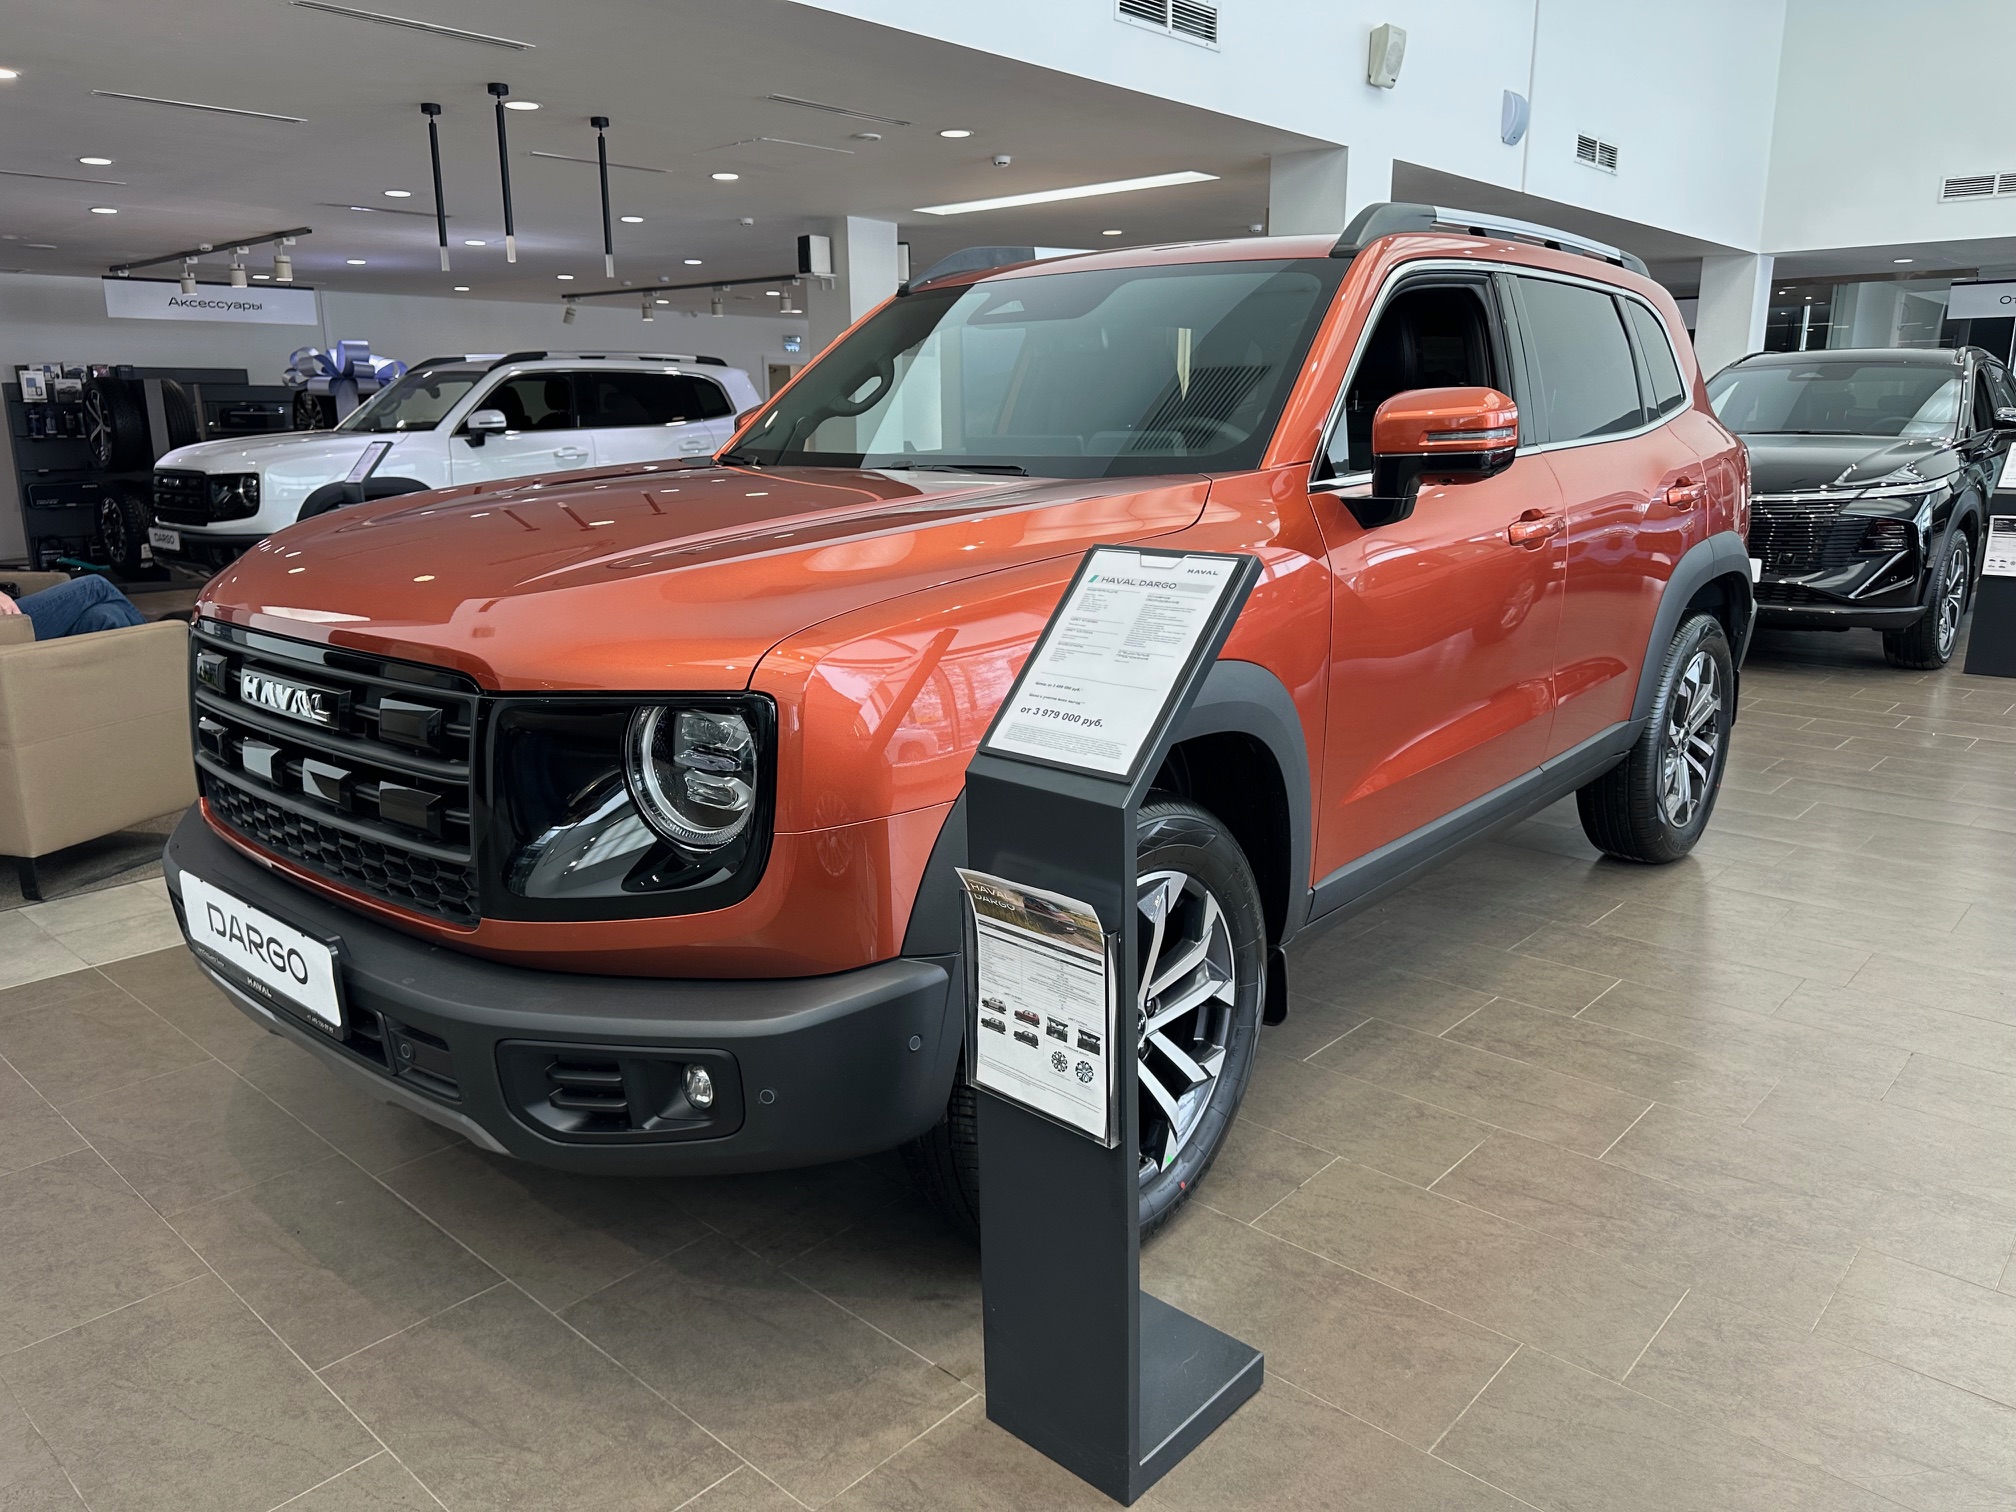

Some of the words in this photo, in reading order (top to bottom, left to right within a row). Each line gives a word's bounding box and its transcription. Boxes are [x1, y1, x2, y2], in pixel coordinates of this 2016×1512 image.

[168, 296, 263, 312] Аксессуары
[1187, 568, 1218, 576] HAVAL
[1101, 576, 1136, 587] HAVAL
[1139, 579, 1177, 590] DARGO
[243, 674, 331, 722] HAVAL
[1020, 706, 1031, 714] от
[1033, 707, 1040, 716] 3
[1041, 708, 1060, 719] 979
[1061, 712, 1081, 723] 000
[1081, 718, 1103, 728] руб.
[969, 882, 1012, 901] HAVAL
[206, 900, 309, 985] DARGO
